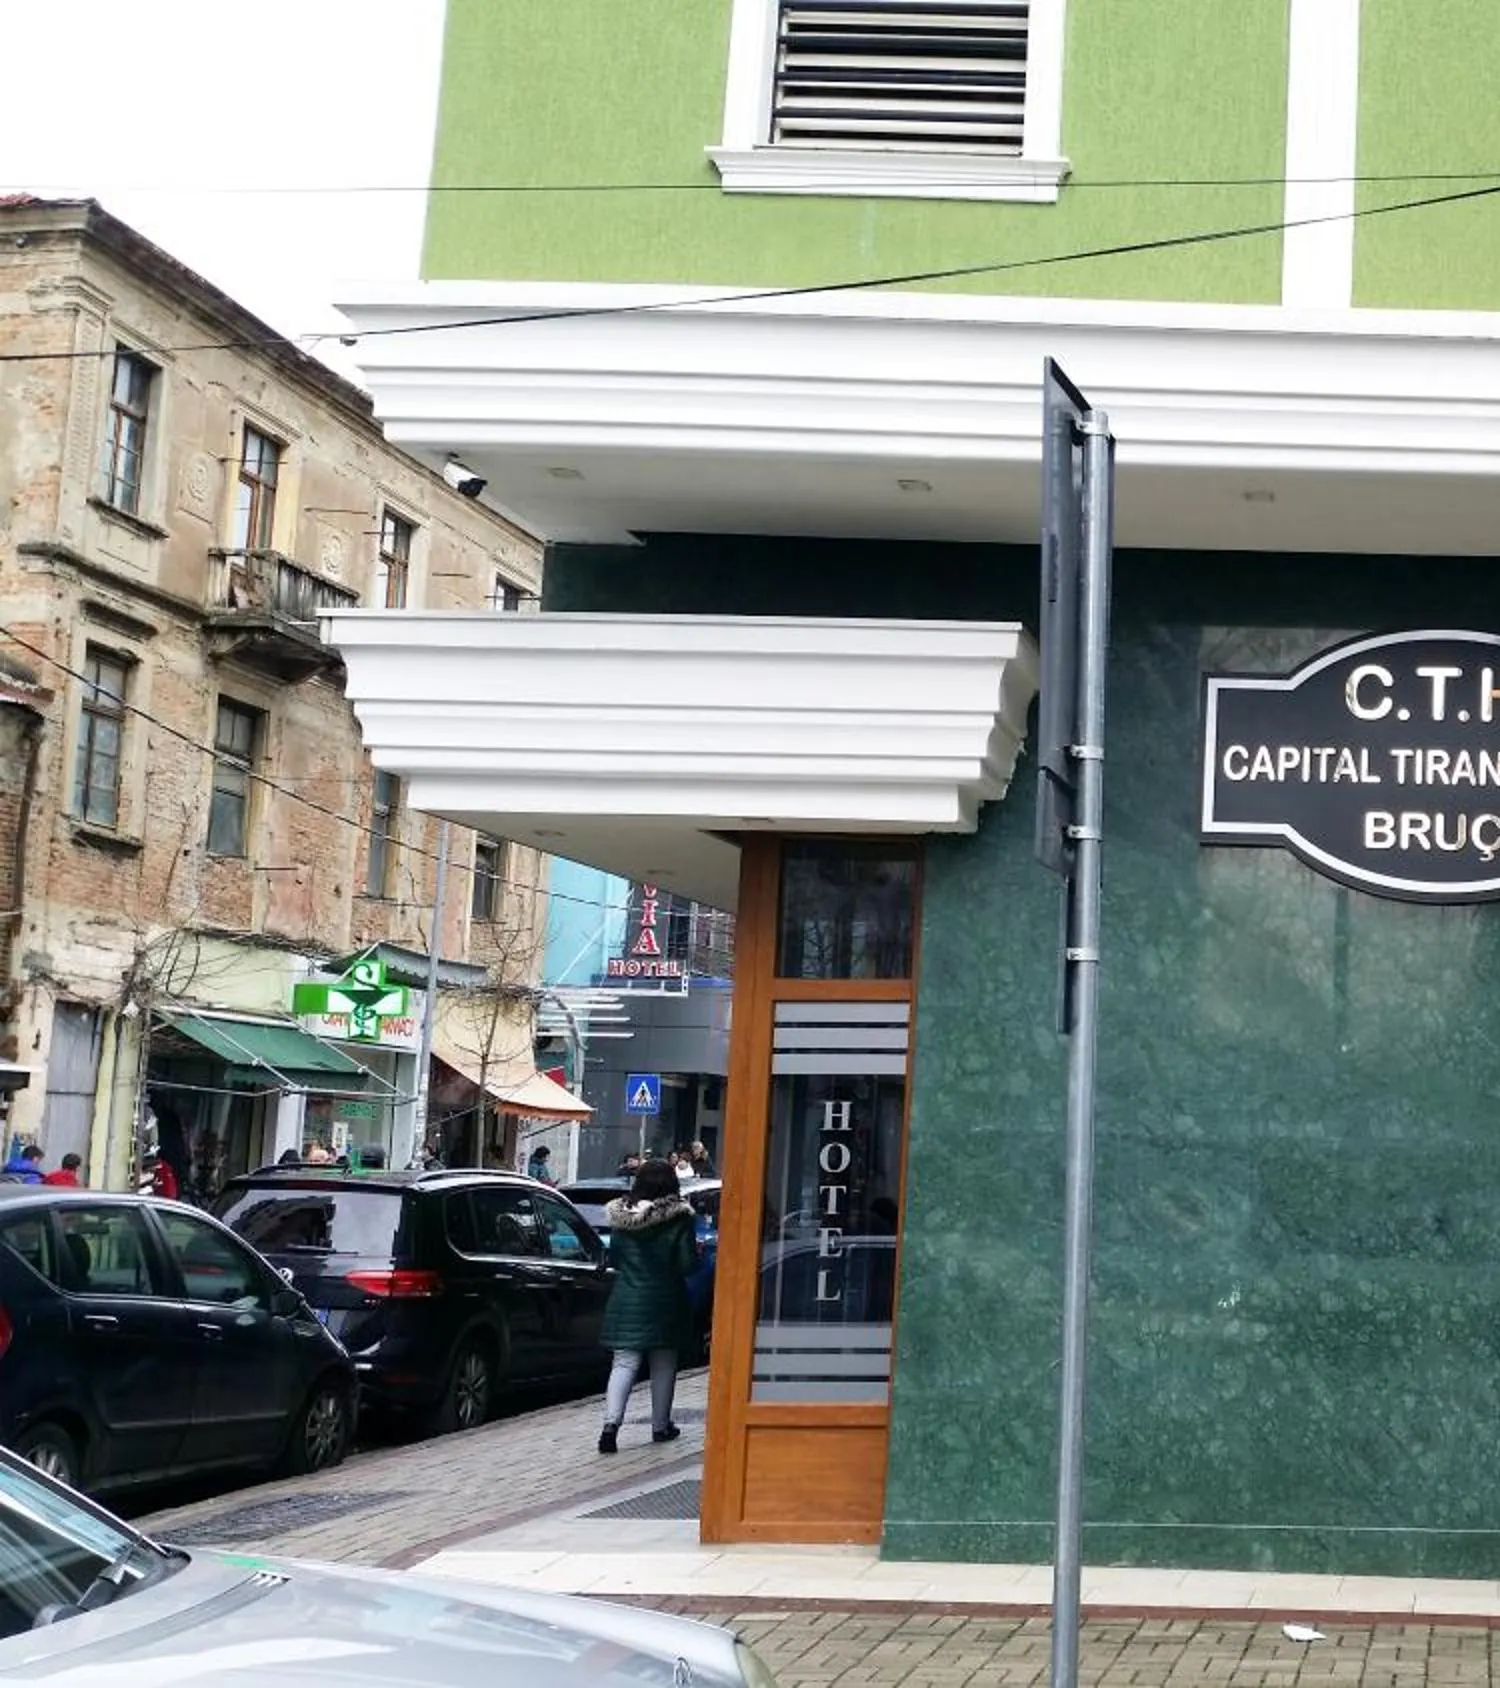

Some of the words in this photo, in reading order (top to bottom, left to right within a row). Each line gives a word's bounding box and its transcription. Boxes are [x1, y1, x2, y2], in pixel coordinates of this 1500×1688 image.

[1222, 745, 1381, 785] CAPITAL
[608, 959, 681, 977] HOTEL
[815, 1101, 853, 1301] HOTEL
